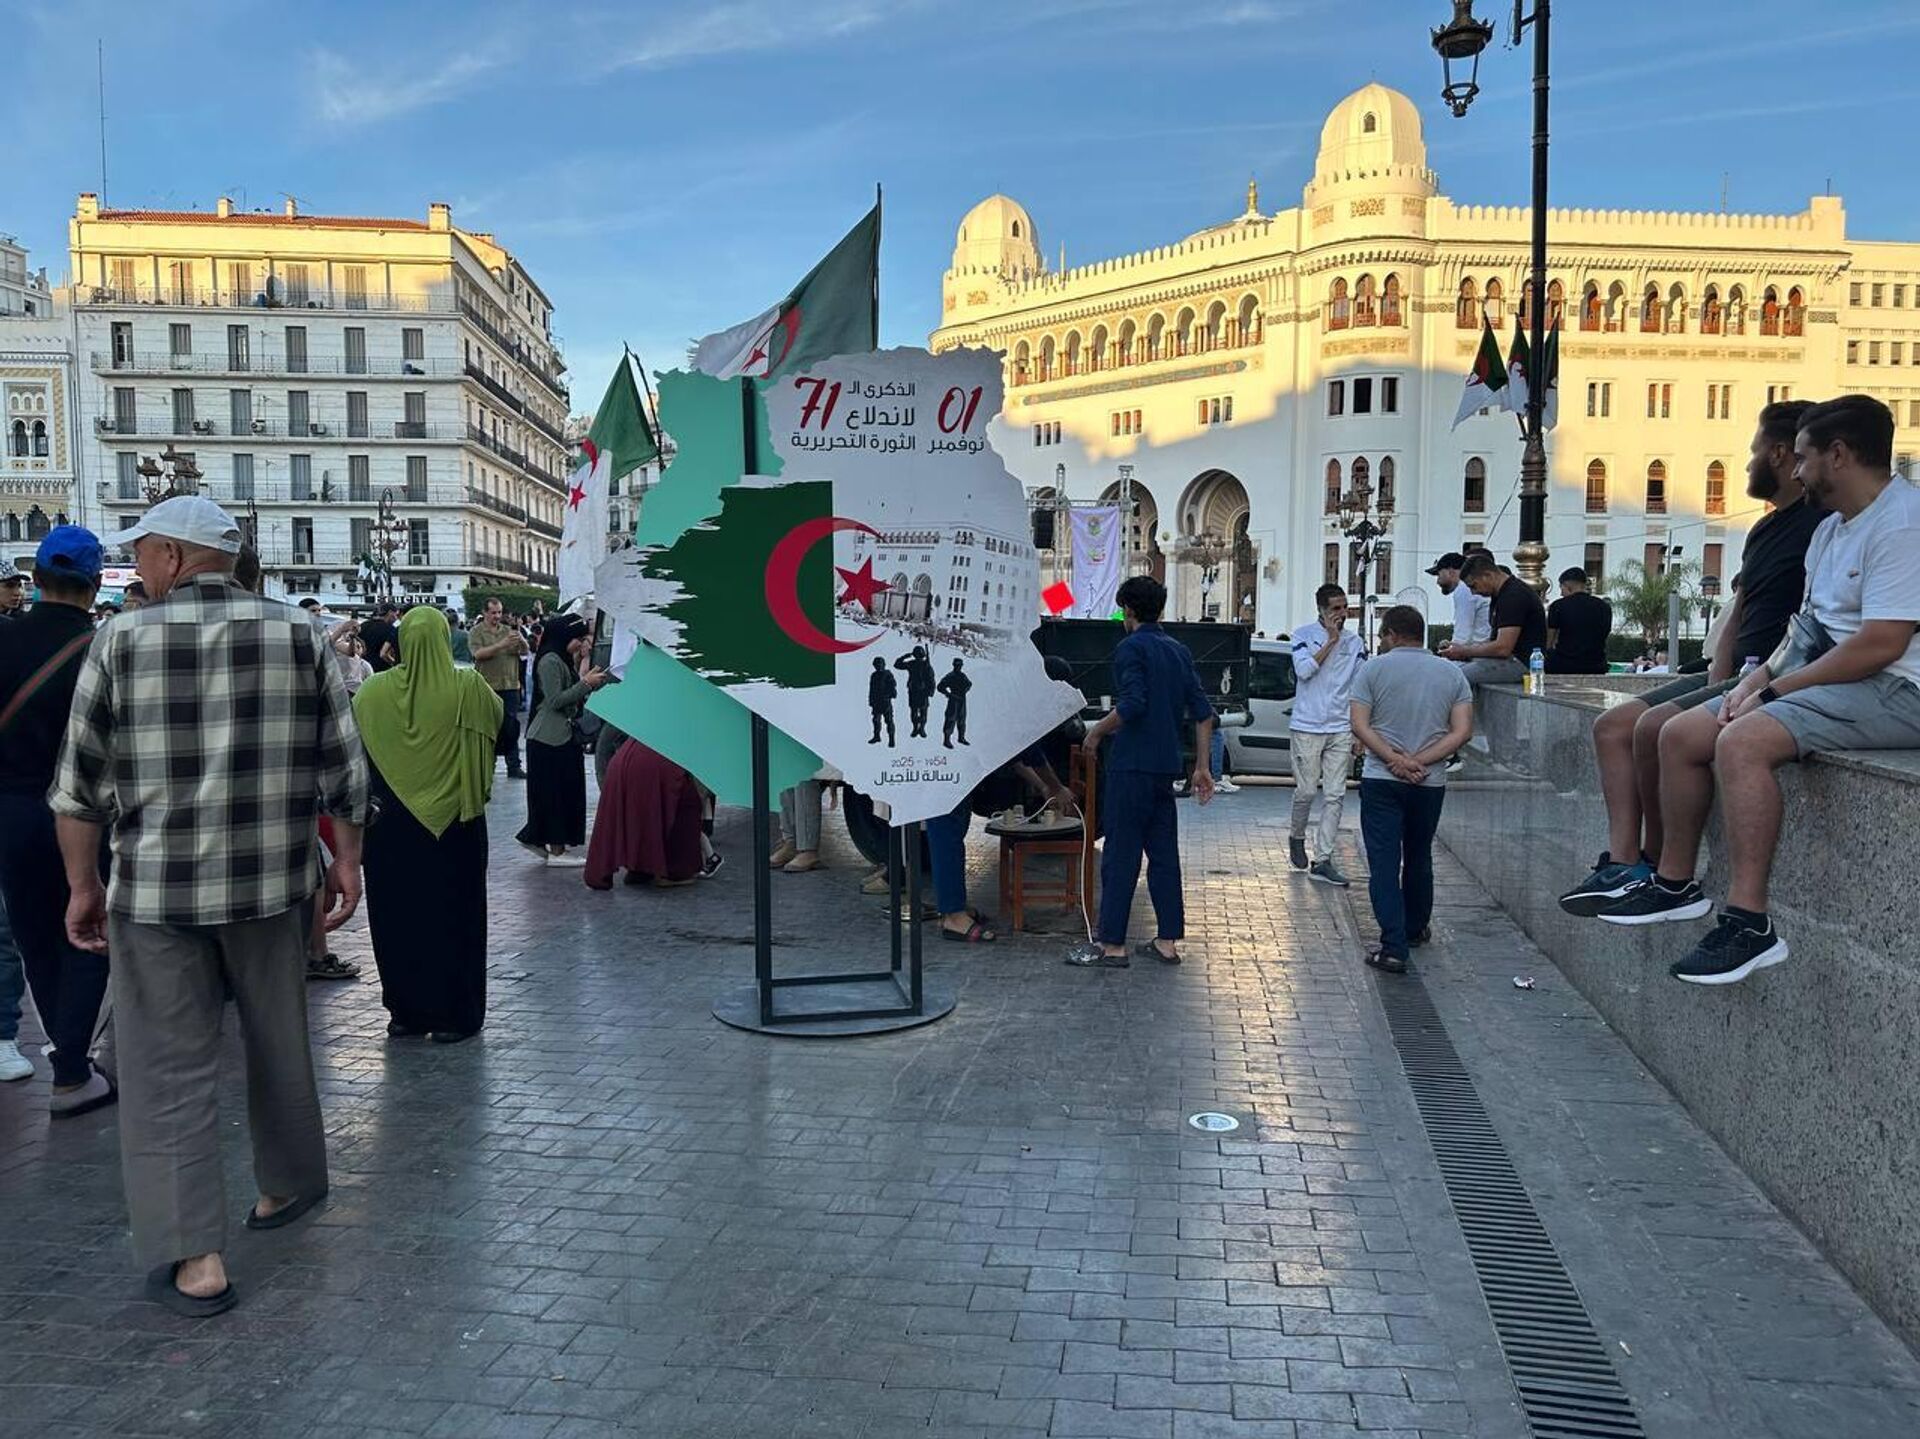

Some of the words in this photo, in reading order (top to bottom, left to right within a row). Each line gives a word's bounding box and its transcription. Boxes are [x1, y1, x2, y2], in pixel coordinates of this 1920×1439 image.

[864, 381, 916, 399] الذكرى
[794, 377, 842, 431] 71
[936, 386, 983, 434] 01
[846, 406, 915, 431] لاندلاع
[791, 432, 866, 452] التحريرية
[870, 432, 916, 453] الثورة
[927, 435, 985, 455] نوفمبر
[873, 768, 920, 786] للأجيال
[921, 769, 961, 785] رسالة
